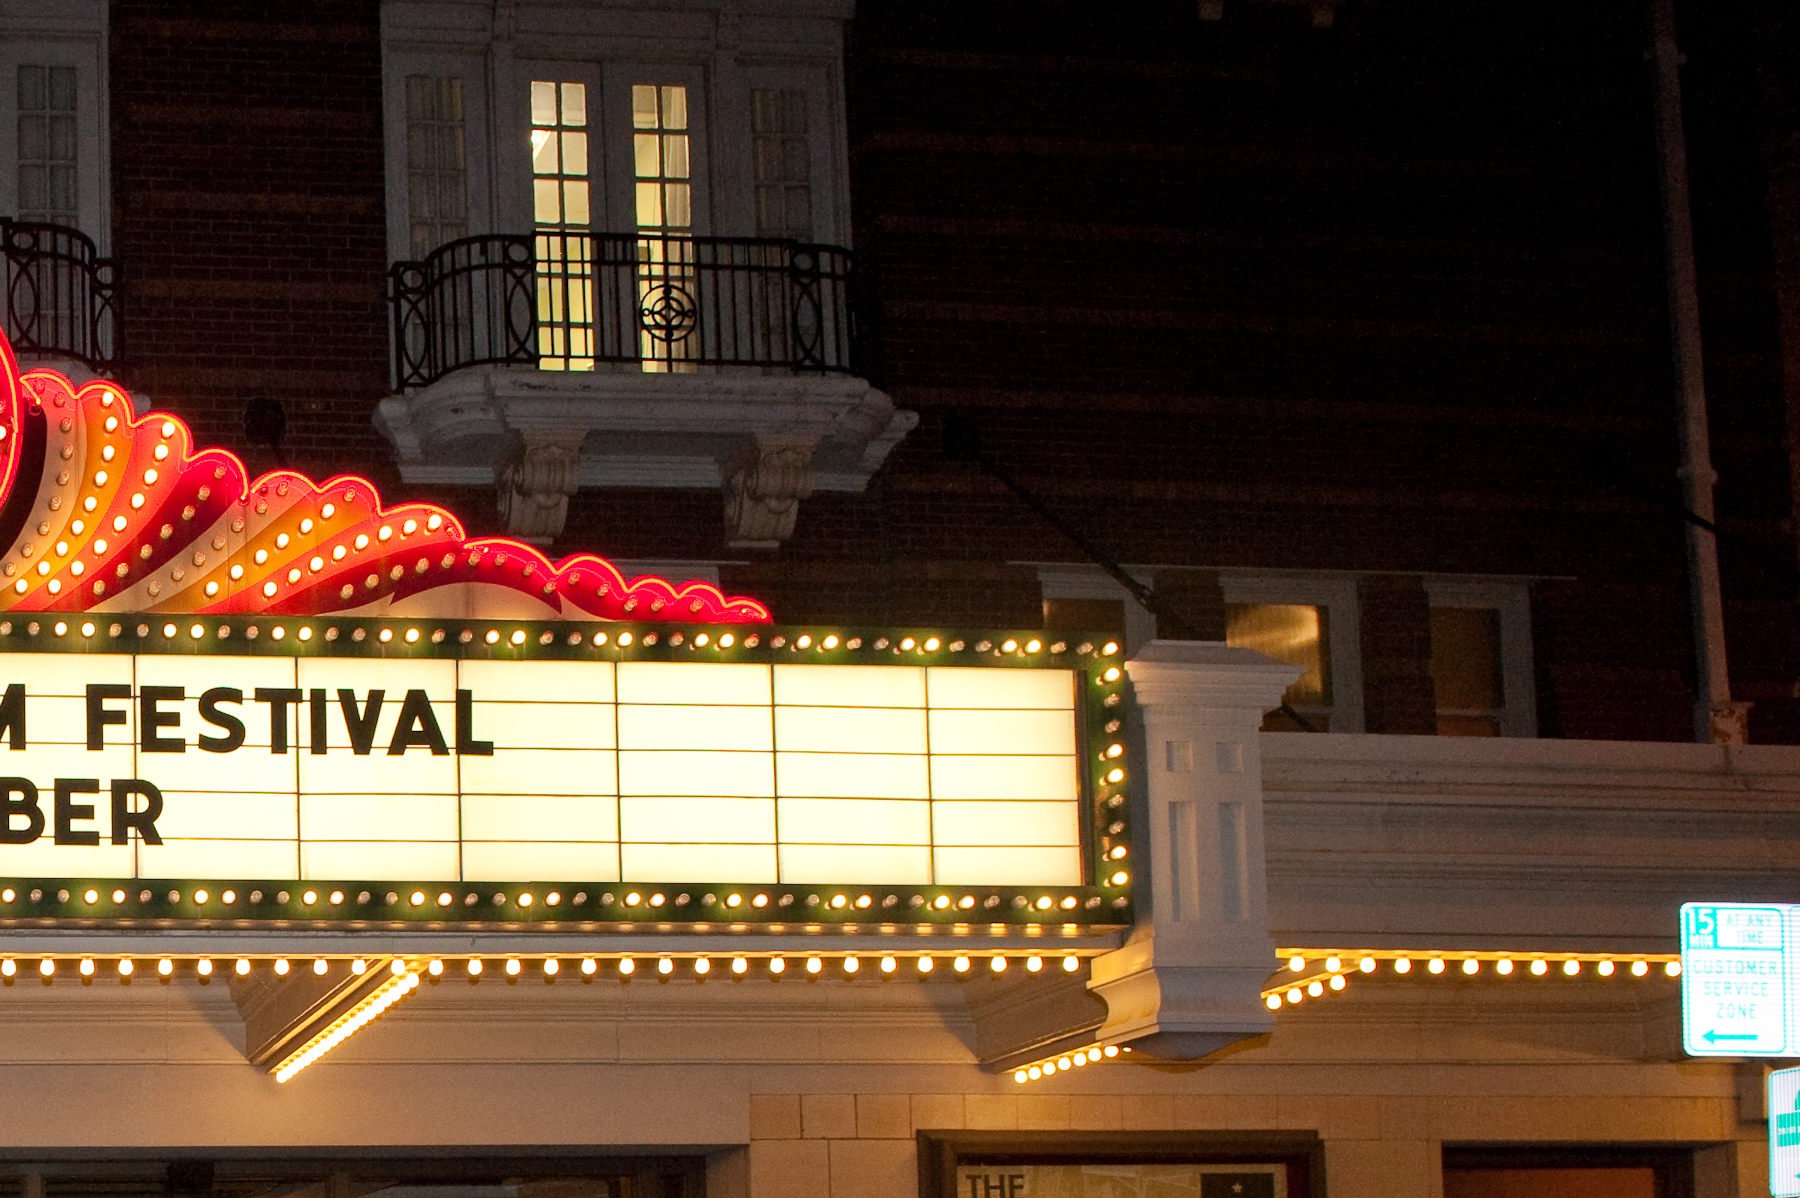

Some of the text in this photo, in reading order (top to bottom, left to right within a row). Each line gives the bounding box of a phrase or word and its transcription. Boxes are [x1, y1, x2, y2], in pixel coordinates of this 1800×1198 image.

[85, 683, 495, 758] FESTIVAL
[1689, 908, 1715, 935] 15
[1693, 959, 1777, 976] CUSTOMER
[1703, 981, 1769, 997] SERVICE
[1716, 1003, 1757, 1019] ZONE
